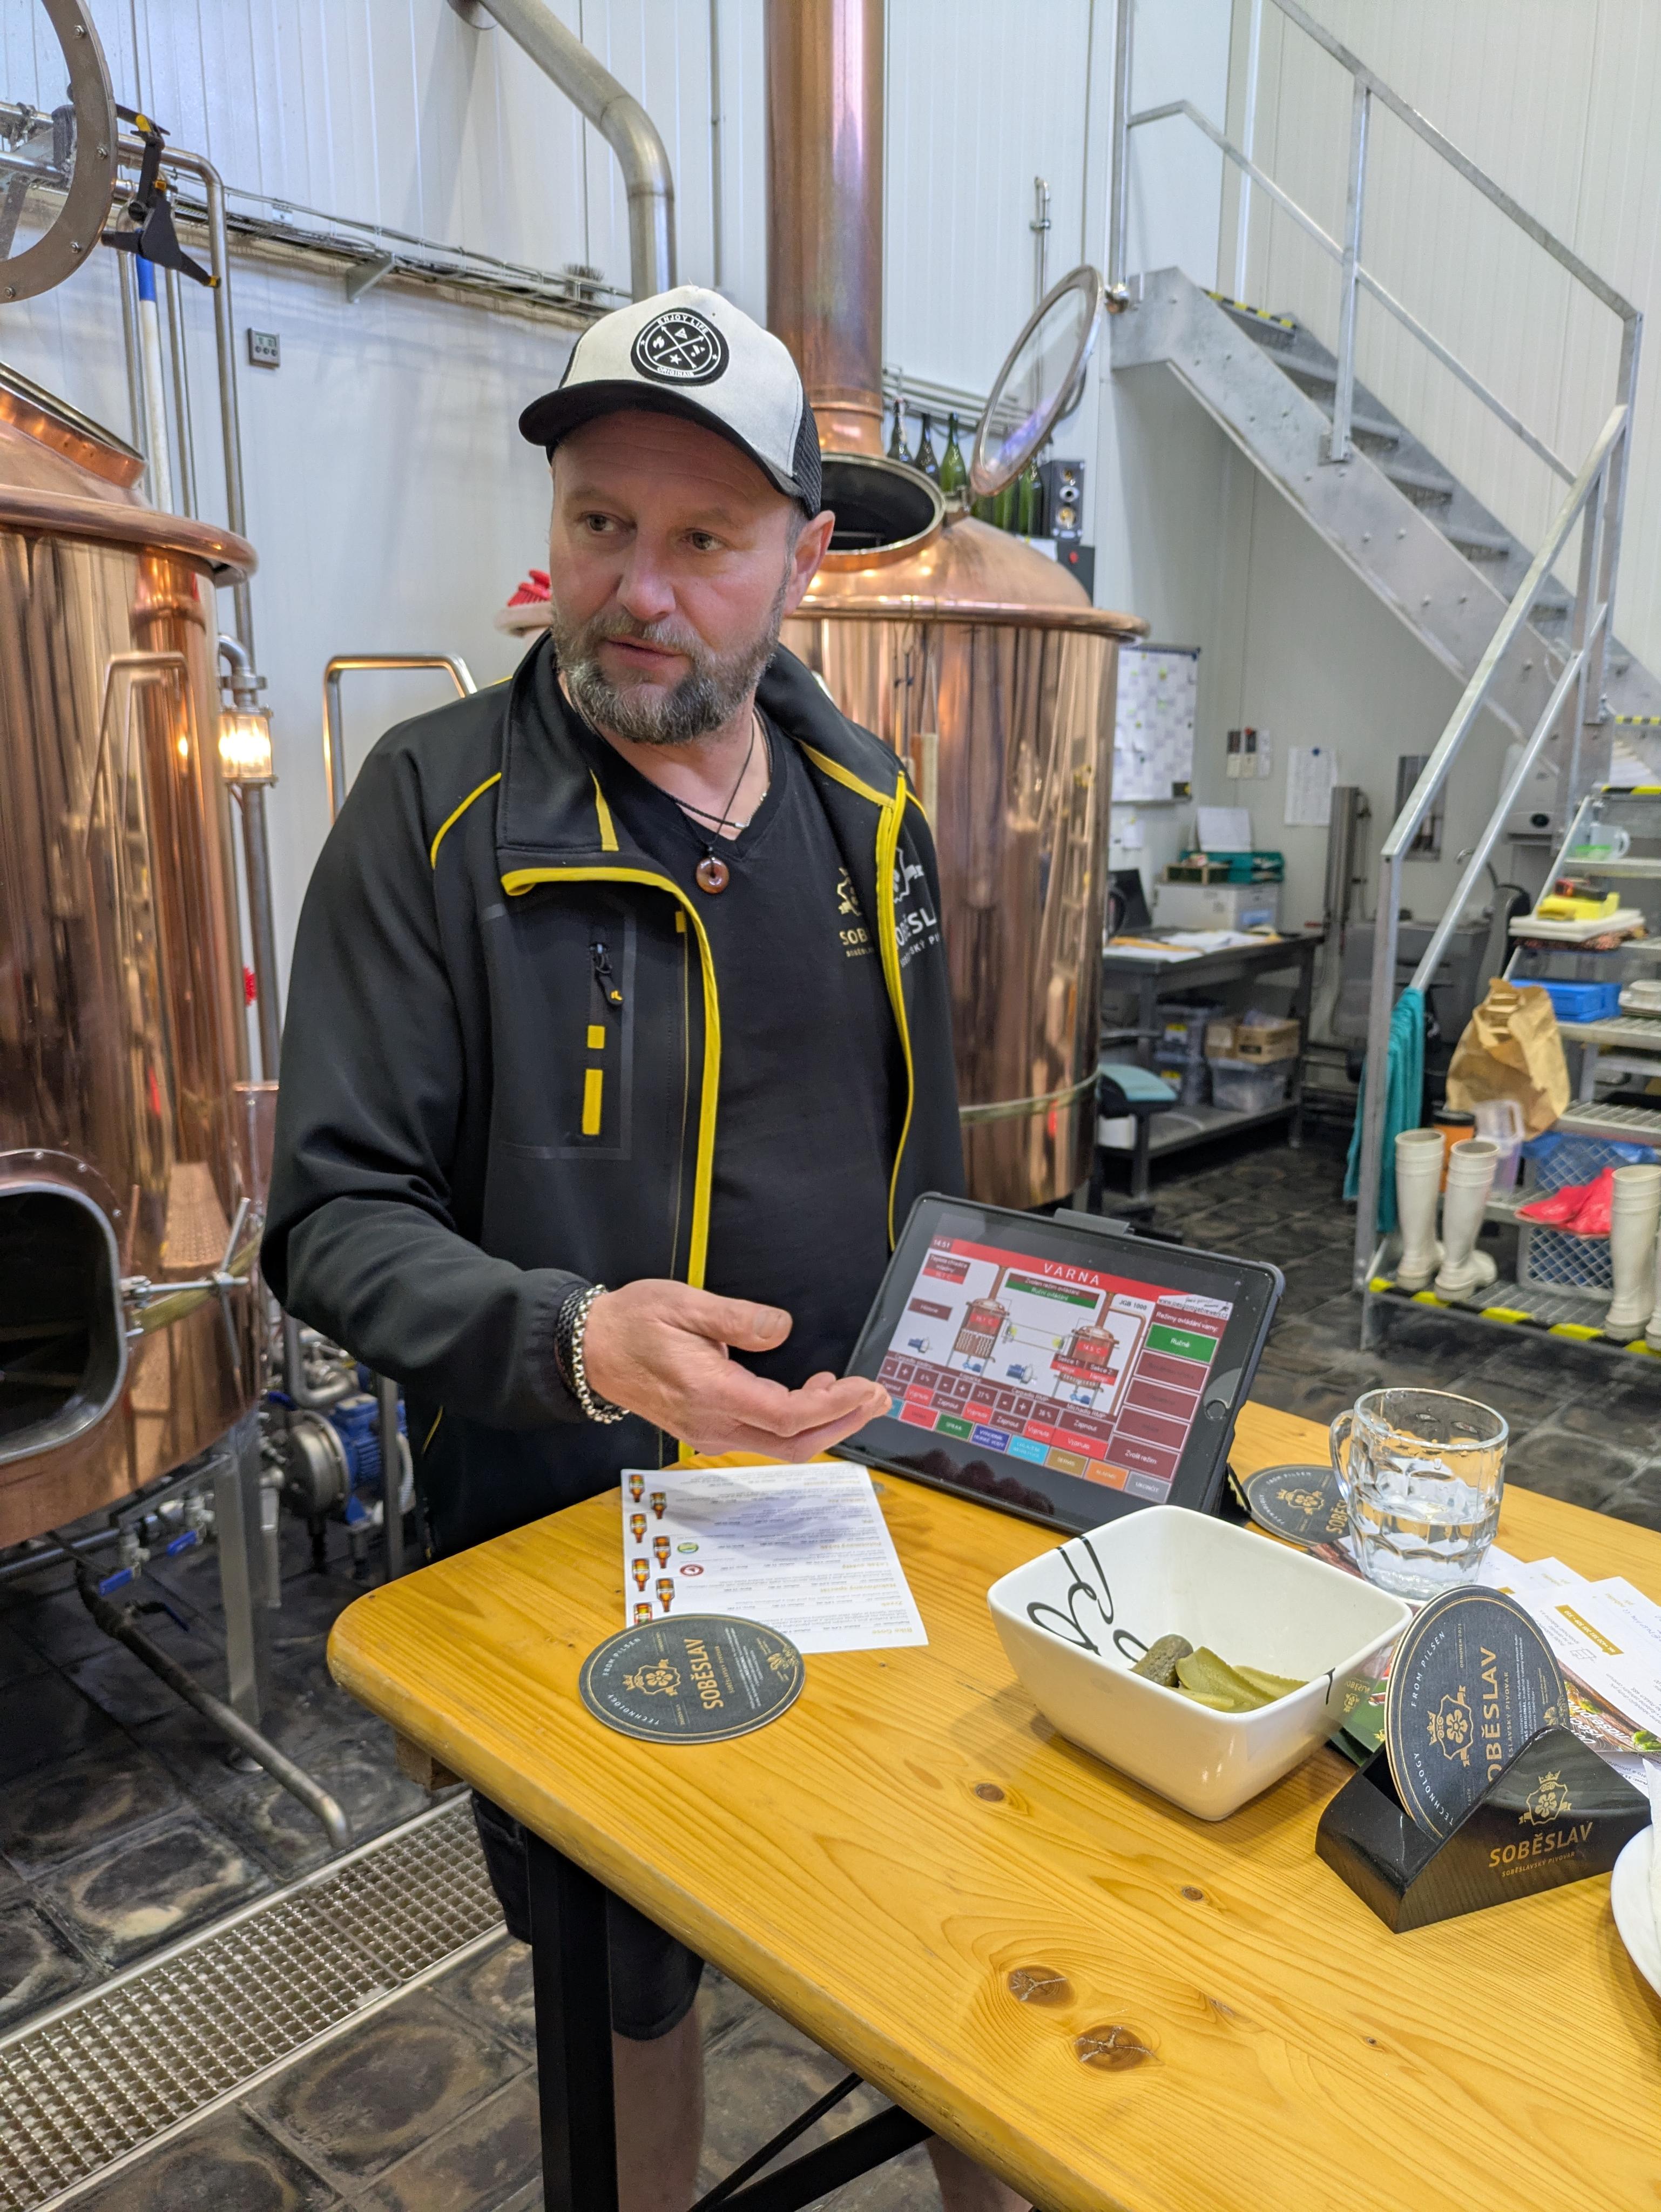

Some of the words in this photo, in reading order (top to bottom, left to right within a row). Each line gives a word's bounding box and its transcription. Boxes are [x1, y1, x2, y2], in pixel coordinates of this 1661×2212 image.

[657, 314, 688, 325] ENJOY
[691, 318, 709, 334] LIFE
[1043, 1263, 1100, 1286] VARNA
[1133, 1301, 1147, 1311] 1000
[1156, 1311, 1178, 1323] Režimy
[1178, 1316, 1201, 1328] ovládání
[1170, 1338, 1191, 1348] Ručně
[1057, 1355, 1075, 1364] Sekce
[1090, 1364, 1108, 1373] Sekce
[997, 1415, 1019, 1428] Zapnout
[1073, 1419, 1098, 1431] Zapnout
[602, 1658, 616, 1676] FROM
[613, 1637, 642, 1658] PILSEN
[684, 1638, 725, 1710] SOBĚSLAV
[1411, 1672, 1423, 1707] FROM
[1421, 1631, 1445, 1668] PILSEN
[607, 1694, 660, 1725] TECHNOLOGY
[1480, 1647, 1502, 1782] OBĚSLAV
[1506, 1712, 1514, 1758] ĚSLAVSKÝ
[1592, 1715, 1630, 1739] naše
[1604, 1757, 1631, 1773] přiměřen
[1414, 1752, 1454, 1826] TECHNOLOGY
[1489, 1822, 1594, 1867] SOBĚSLAV
[1548, 1851, 1576, 1865] PIVOVAR
